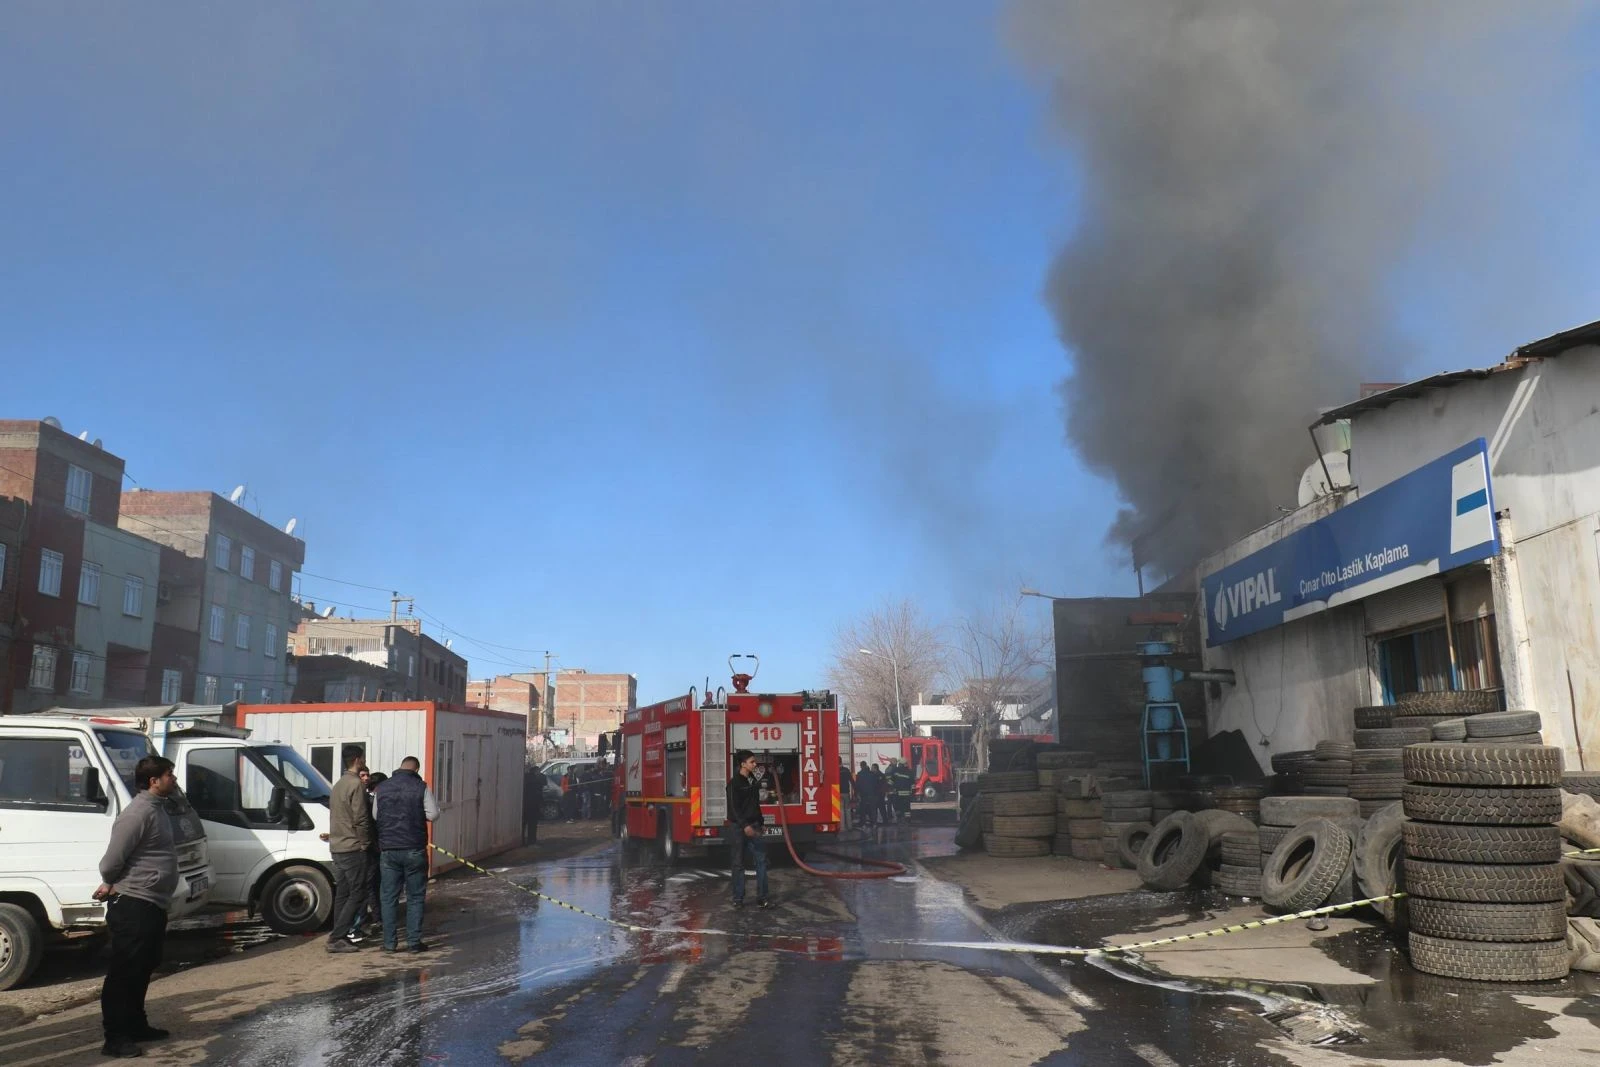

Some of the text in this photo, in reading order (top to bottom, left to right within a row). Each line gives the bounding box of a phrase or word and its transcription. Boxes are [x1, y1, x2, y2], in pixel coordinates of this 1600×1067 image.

[1227, 567, 1281, 618] VIPAL
[1300, 579, 1320, 599] Çınar
[1337, 559, 1364, 582] Lastik
[1365, 544, 1409, 573] Kaplama
[750, 727, 782, 740] 110
[803, 716, 818, 815] İTFAİYE
